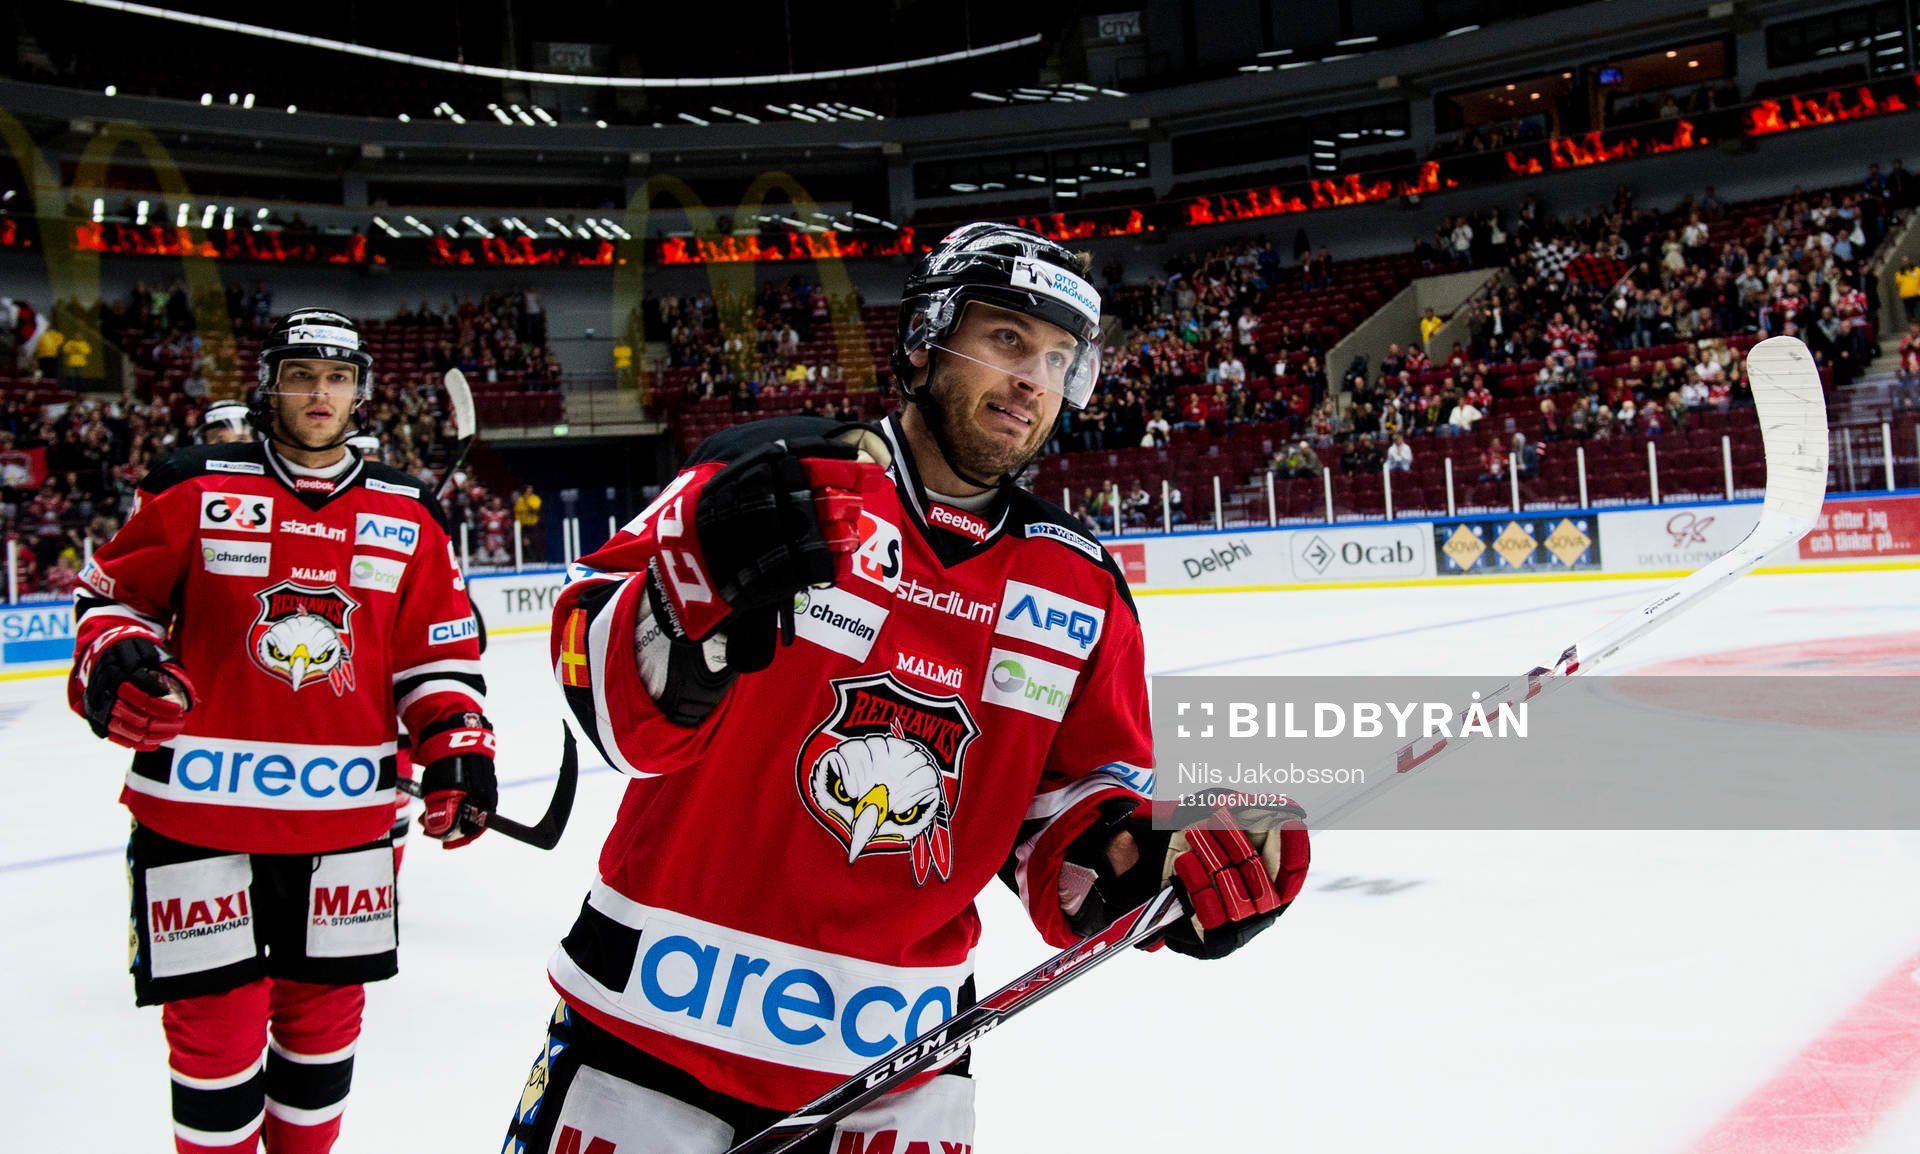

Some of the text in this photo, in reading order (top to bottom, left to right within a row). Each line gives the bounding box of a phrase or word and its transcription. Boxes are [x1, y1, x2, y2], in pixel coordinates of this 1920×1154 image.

[1054, 273, 1078, 290] OTTO
[296, 479, 335, 491] Reebok
[205, 497, 267, 529] G4S
[930, 506, 988, 540] Reebok
[280, 520, 347, 542] stadium
[1498, 538, 1532, 551] SOVA
[1550, 536, 1585, 549] SOVA
[217, 552, 267, 564] charden
[1182, 538, 1253, 579] Delphi
[1342, 540, 1414, 565] Ocab
[292, 567, 337, 582] MALMÖ
[897, 578, 997, 625] stadium
[2, 612, 69, 640] SAN
[810, 604, 875, 642] charden
[896, 652, 963, 689] MALMÖ
[844, 689, 964, 764] REDHAWKS
[177, 748, 376, 798] areco
[152, 890, 249, 933] MAXI
[313, 885, 393, 916] MAXI
[168, 916, 250, 942] STORMARKNAD
[640, 935, 953, 1058] areco
[934, 1017, 999, 1062] CCM
[865, 1029, 949, 1089] CCM
